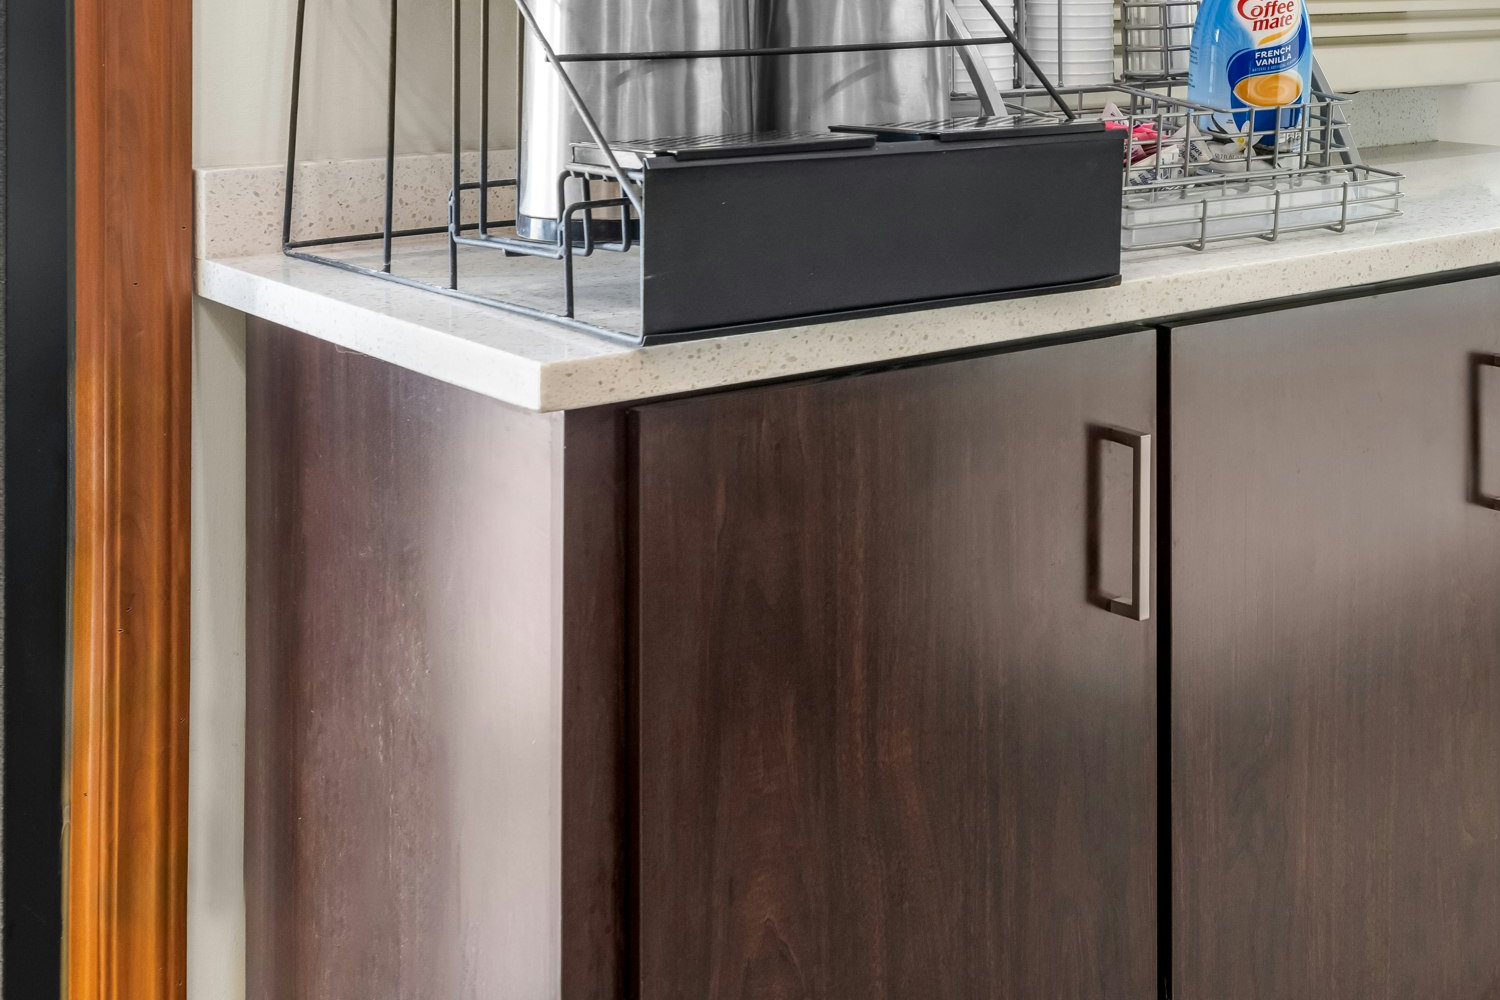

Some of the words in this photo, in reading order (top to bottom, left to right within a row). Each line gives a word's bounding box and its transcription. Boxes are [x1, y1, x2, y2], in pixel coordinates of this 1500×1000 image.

[1252, 13, 1294, 31] mate
[1255, 45, 1291, 59] FRENCH
[1255, 53, 1292, 67] VANILLA
